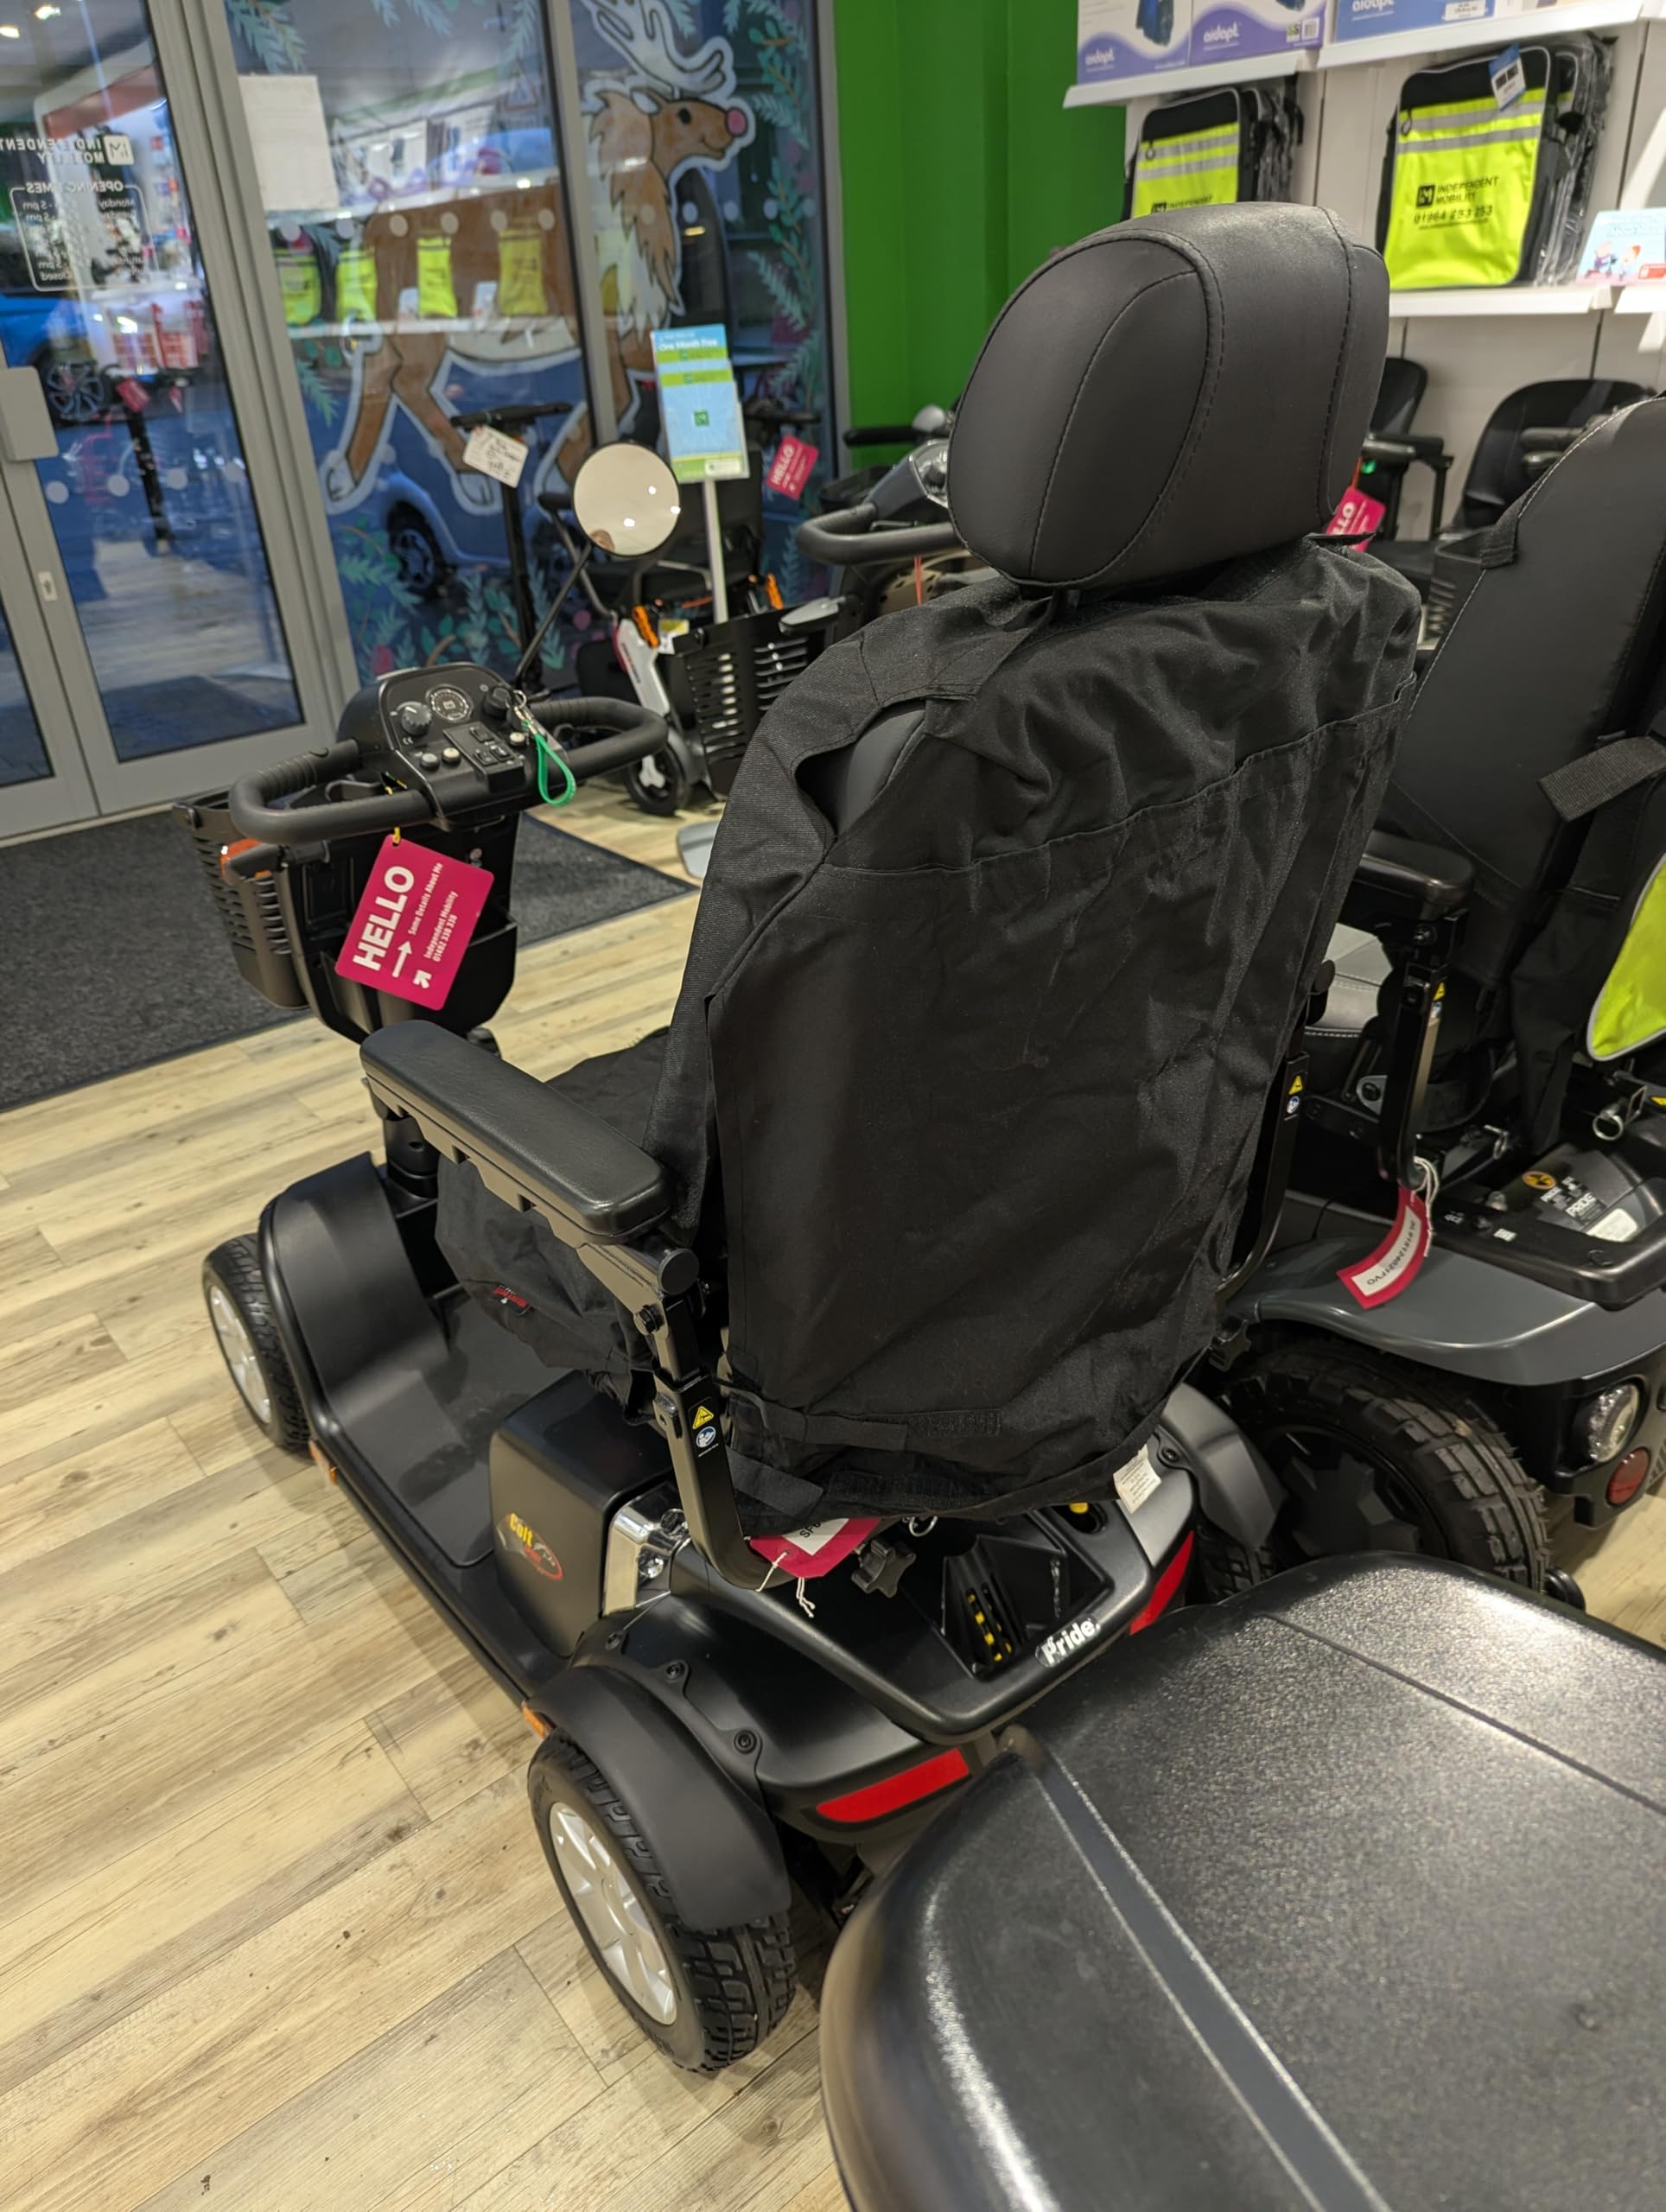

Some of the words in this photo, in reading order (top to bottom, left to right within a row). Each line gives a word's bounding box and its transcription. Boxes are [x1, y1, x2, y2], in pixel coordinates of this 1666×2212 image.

[353, 866, 415, 971] HELLO
[408, 917, 421, 935] Some
[416, 893, 431, 917] Details
[425, 870, 439, 893] About
[436, 862, 443, 875] Me
[423, 915, 446, 959] Independent
[441, 891, 459, 918] Mobility
[510, 1513, 532, 1548] Colt
[1041, 1618, 1096, 1664] Pride
